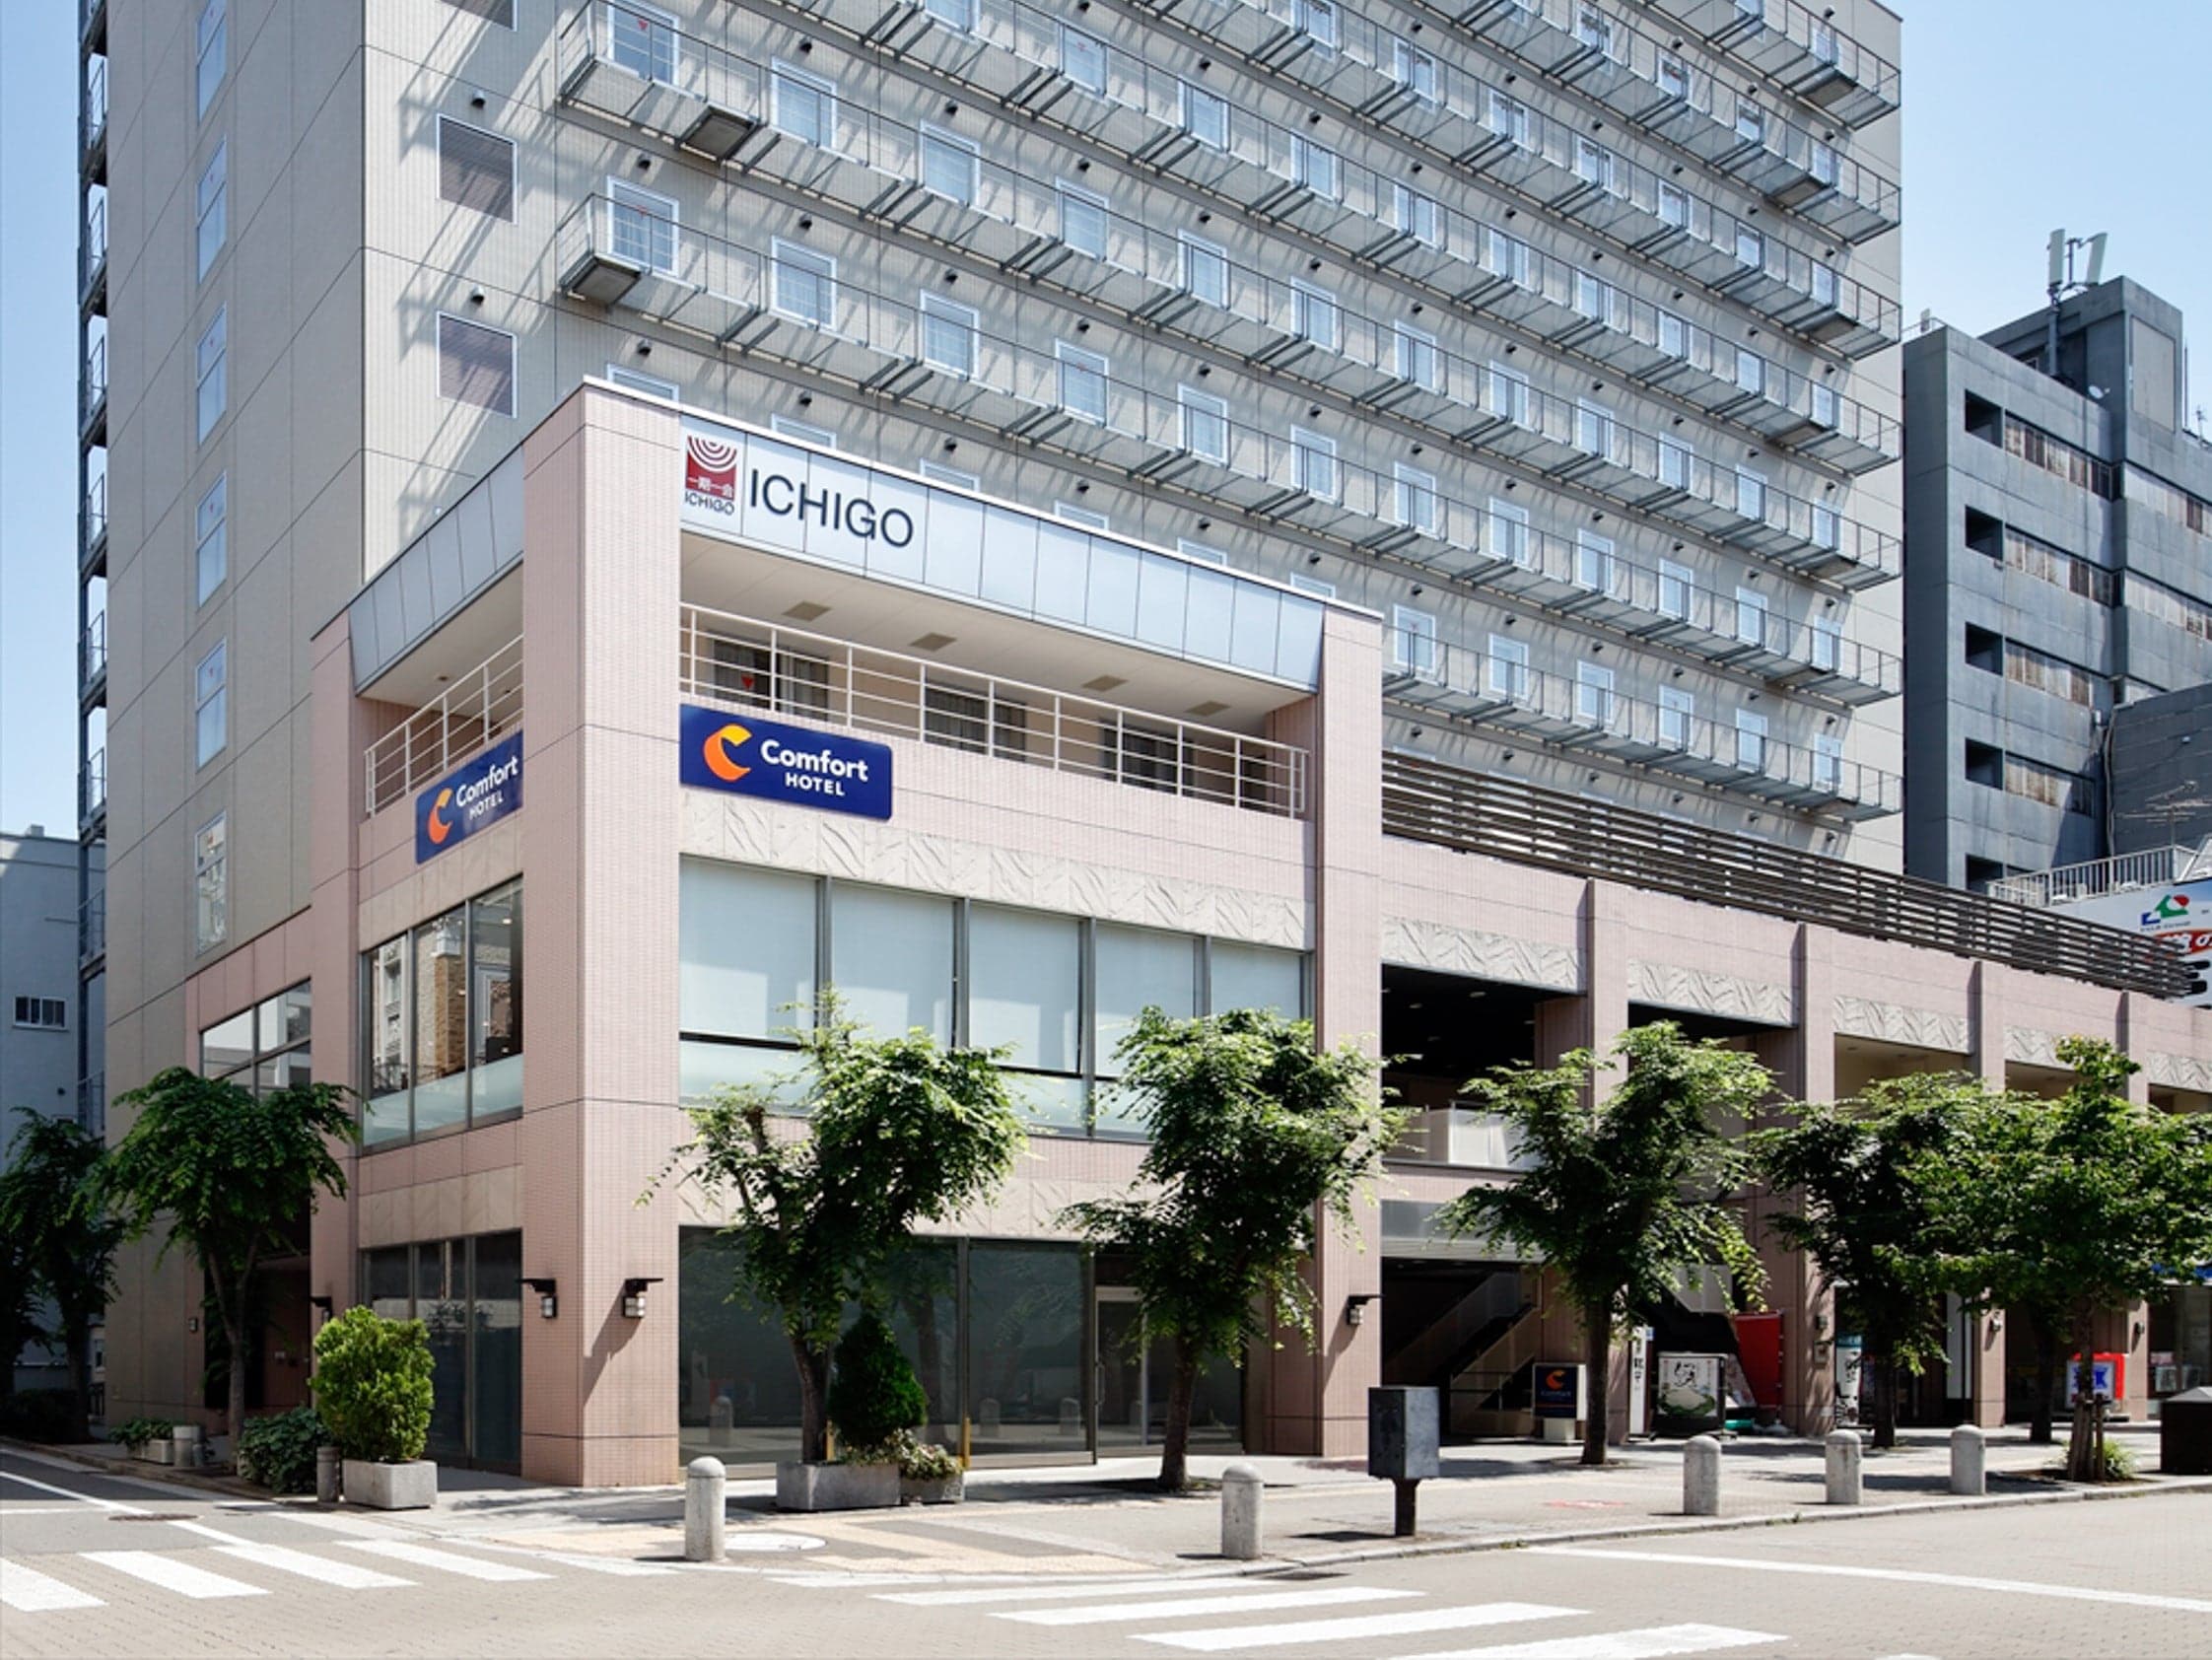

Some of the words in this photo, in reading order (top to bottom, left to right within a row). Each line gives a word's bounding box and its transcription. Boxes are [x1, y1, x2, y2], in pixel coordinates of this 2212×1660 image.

[685, 491, 735, 517] ICHIGO
[750, 468, 914, 548] ICHIGO
[760, 739, 868, 782] Comfort
[456, 755, 518, 807] Comfort
[785, 772, 846, 796] HOTEL
[469, 790, 504, 820] HOTEL
